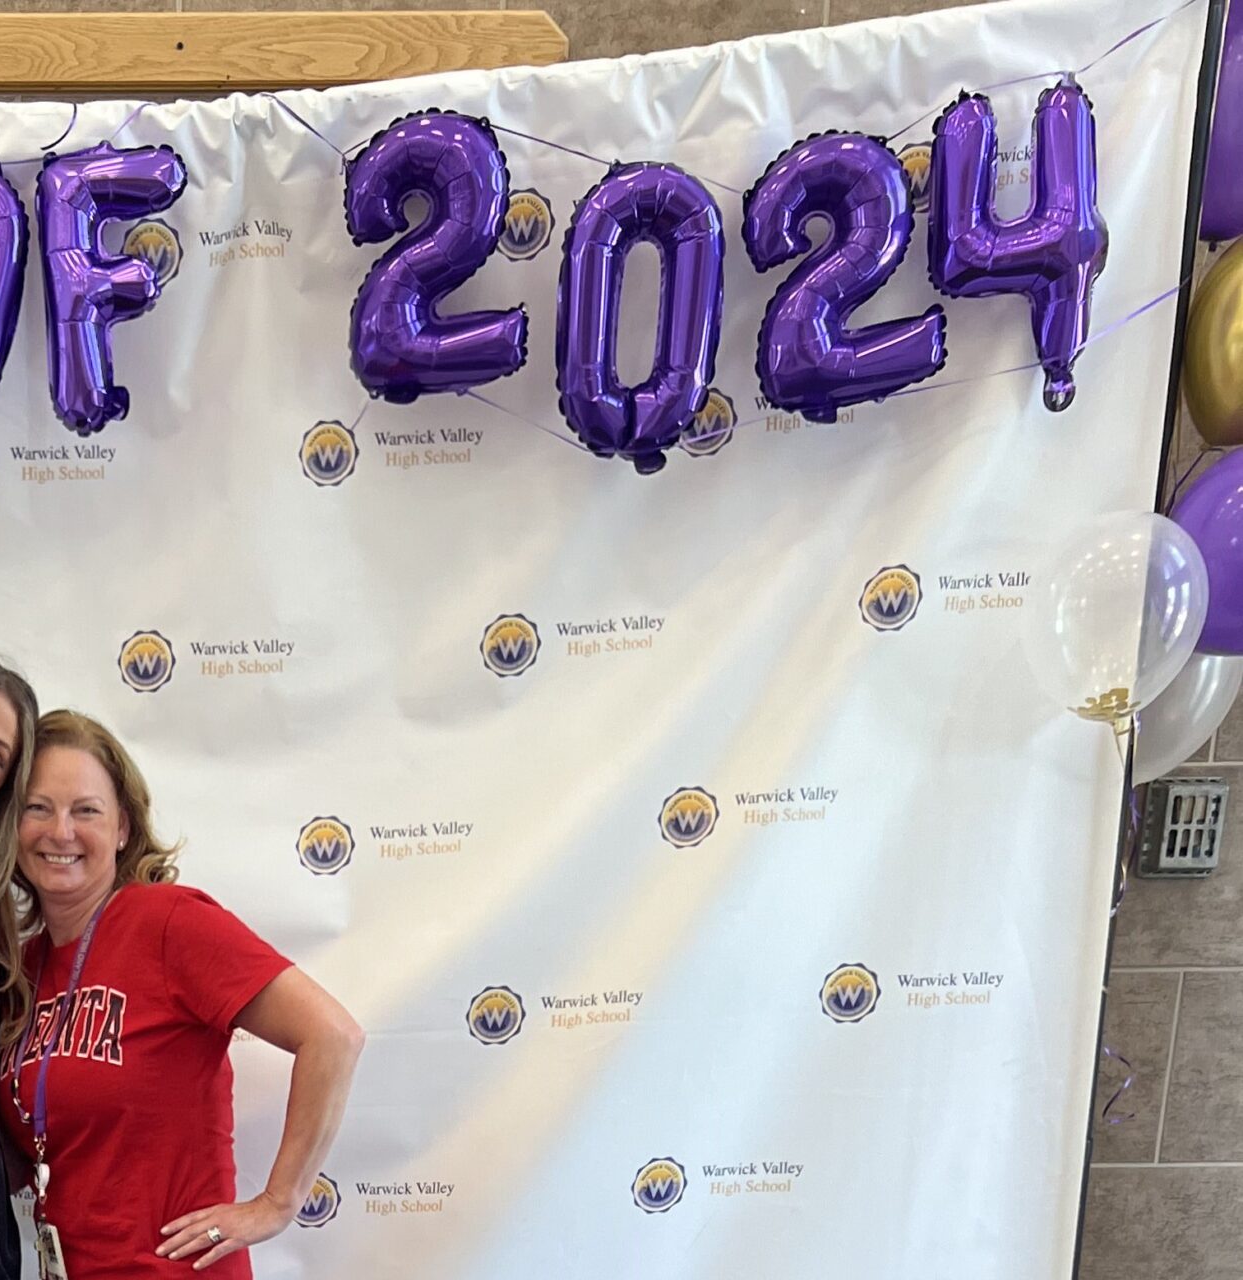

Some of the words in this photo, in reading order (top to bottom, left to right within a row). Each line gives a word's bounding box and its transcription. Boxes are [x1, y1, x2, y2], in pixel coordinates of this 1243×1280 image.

[199, 222, 249, 247] Warwick
[255, 220, 292, 242] Valley
[210, 246, 234, 265] High
[240, 243, 284, 258] School
[345, 73, 1109, 474] 2024
[375, 431, 436, 446] Warwick
[441, 429, 483, 447] Valley
[11, 447, 69, 460] Warwick
[75, 446, 116, 463] Valley
[386, 451, 420, 468] High
[424, 448, 470, 465] School
[22, 466, 54, 482] High
[58, 466, 104, 480] School
[557, 619, 617, 636] Warwick
[622, 616, 665, 631] Valley
[191, 641, 248, 655] Warwick
[253, 640, 295, 656] Valley
[568, 641, 601, 657] High
[605, 636, 652, 651] School
[201, 662, 234, 677] High
[238, 660, 283, 674] School
[371, 826, 427, 839] Warwick
[432, 823, 473, 838] Valley
[381, 844, 412, 859] High
[416, 841, 461, 854] School
[898, 975, 957, 987] Warwick
[962, 972, 1003, 988] Valley
[542, 995, 597, 1009] Warwick
[603, 990, 643, 1005] Valley
[907, 992, 940, 1007] High
[945, 992, 990, 1005] School
[551, 1014, 582, 1030] High
[586, 1009, 631, 1024] School
[702, 1165, 757, 1177] Warwick
[762, 1162, 803, 1177] Valley
[356, 1183, 411, 1195] Warwick
[416, 1183, 454, 1197] Valley
[710, 1181, 740, 1196] High
[746, 1179, 791, 1193] School
[365, 1201, 397, 1216] High
[401, 1200, 442, 1213] School
